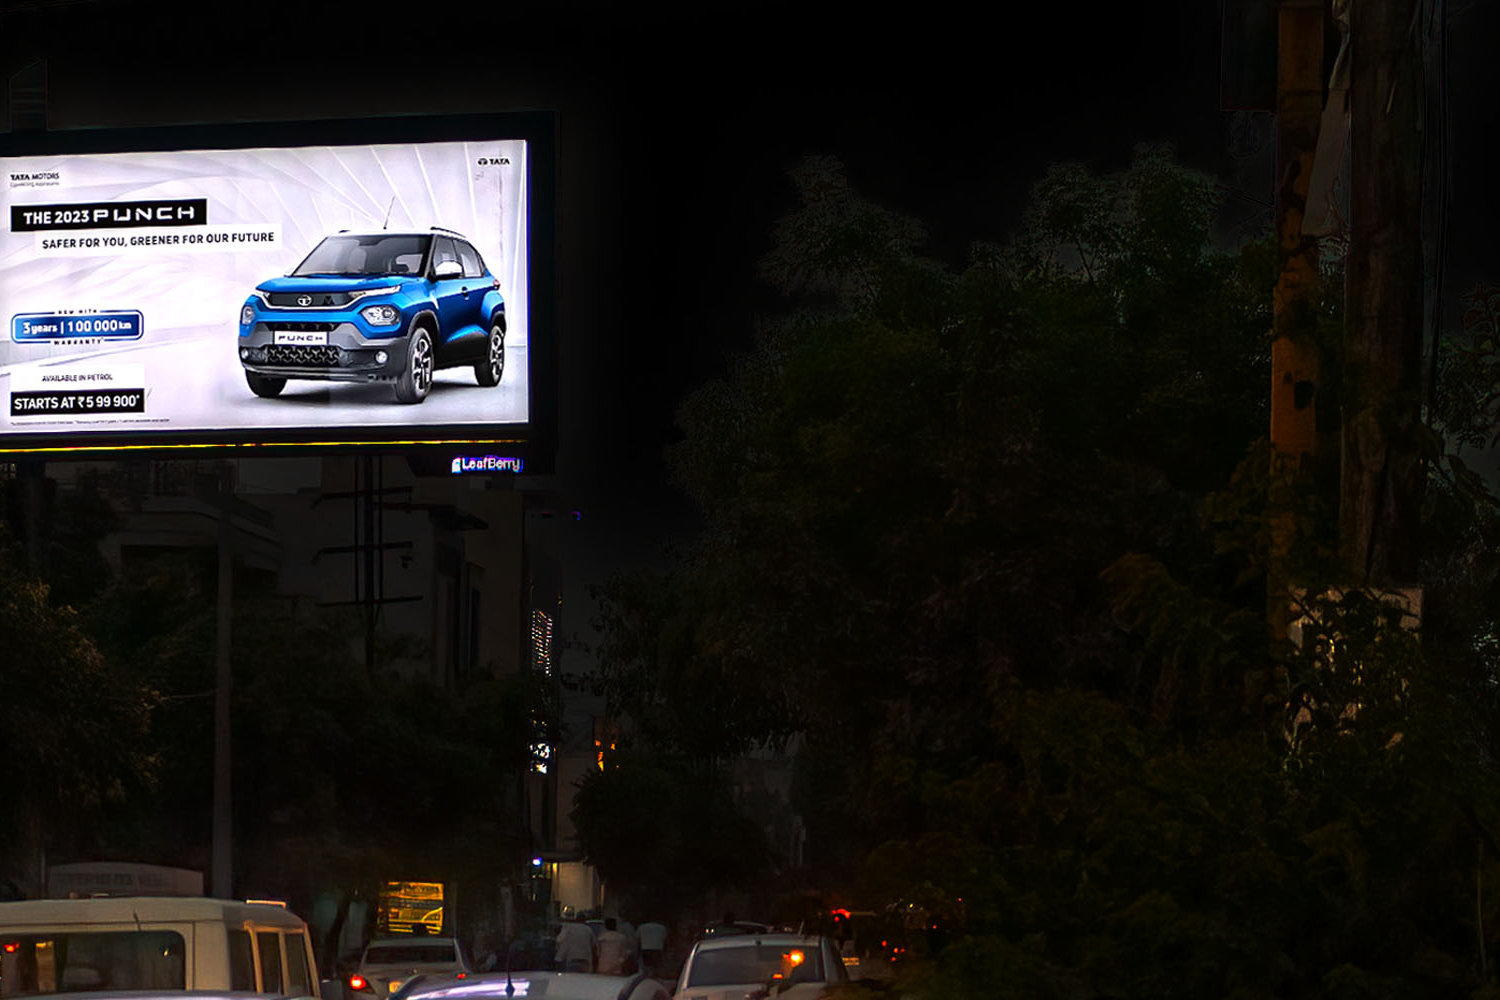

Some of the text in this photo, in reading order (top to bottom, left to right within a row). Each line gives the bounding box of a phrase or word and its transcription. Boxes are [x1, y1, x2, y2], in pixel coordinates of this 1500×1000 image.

[489, 157, 510, 165] TATA
[32, 172, 60, 180] MOTORS
[23, 206, 195, 225] THE 2023 PUNCH
[42, 231, 275, 249] SAFER FOR YOU, GREENER FOR OUR FUTURE
[278, 334, 324, 342] PUNCH
[41, 373, 113, 383] AVAILABLE IN PETROL
[14, 397, 58, 410] STARTS
[61, 396, 76, 409] AT
[462, 457, 523, 473] LeafBerry
